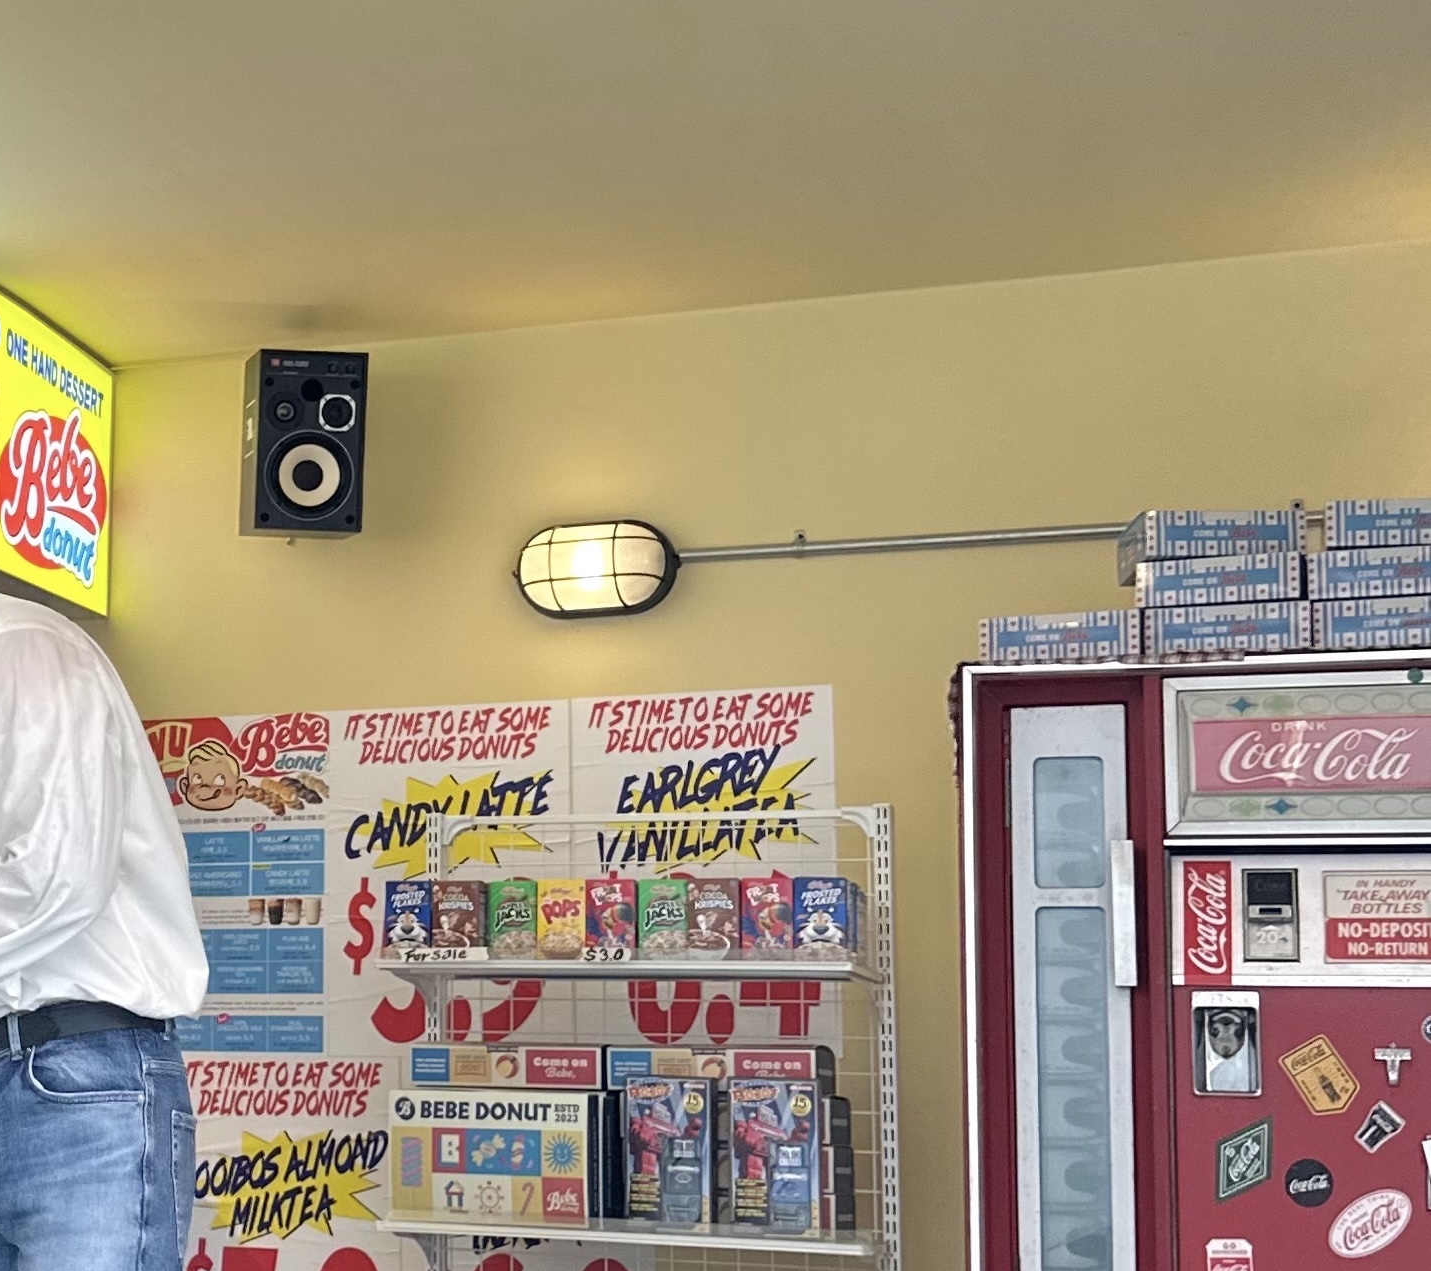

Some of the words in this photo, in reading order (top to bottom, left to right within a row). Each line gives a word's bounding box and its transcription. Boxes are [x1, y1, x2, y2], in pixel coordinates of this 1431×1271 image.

[6, 328, 29, 367] ONE
[30, 349, 59, 388] HAND
[58, 370, 105, 419] DESSERT
[4, 409, 97, 539] Bebe
[41, 517, 95, 584] donut
[458, 707, 496, 734] EAT
[495, 706, 552, 733] SOME
[713, 693, 753, 721] EAT
[753, 691, 815, 720] SOME
[605, 726, 710, 755] DELICIOUS
[711, 719, 800, 748] DONUTS
[1271, 721, 1328, 733] DRINK
[239, 713, 328, 772] Bebe
[359, 736, 455, 765] DELICIOUS
[457, 732, 539, 761] DONUTS
[1219, 726, 1418, 786] Coca-Cola
[274, 752, 326, 773] donut
[1355, 879, 1369, 888] IN
[1373, 879, 1417, 888] HANDY
[540, 898, 582, 925] POPS
[1186, 866, 1227, 975] Coca-Cola
[1350, 902, 1423, 914] BOTTLES
[1347, 941, 1429, 956] NO-RETURN
[295, 1061, 331, 1088] EAT
[330, 1061, 384, 1089] SOME
[533, 1056, 569, 1067] Come
[571, 1058, 588, 1067] on
[742, 1059, 781, 1071] Come
[784, 1061, 802, 1071] on
[197, 1089, 290, 1116] DELICIOUS
[290, 1088, 370, 1117] DONUTS
[420, 1100, 470, 1119] BEBE
[475, 1102, 552, 1121] DONUT
[554, 1103, 580, 1113] ESTD
[554, 1113, 579, 1123] 2023
[194, 1146, 281, 1200] OOIBOS
[282, 1129, 390, 1184] ALMOND
